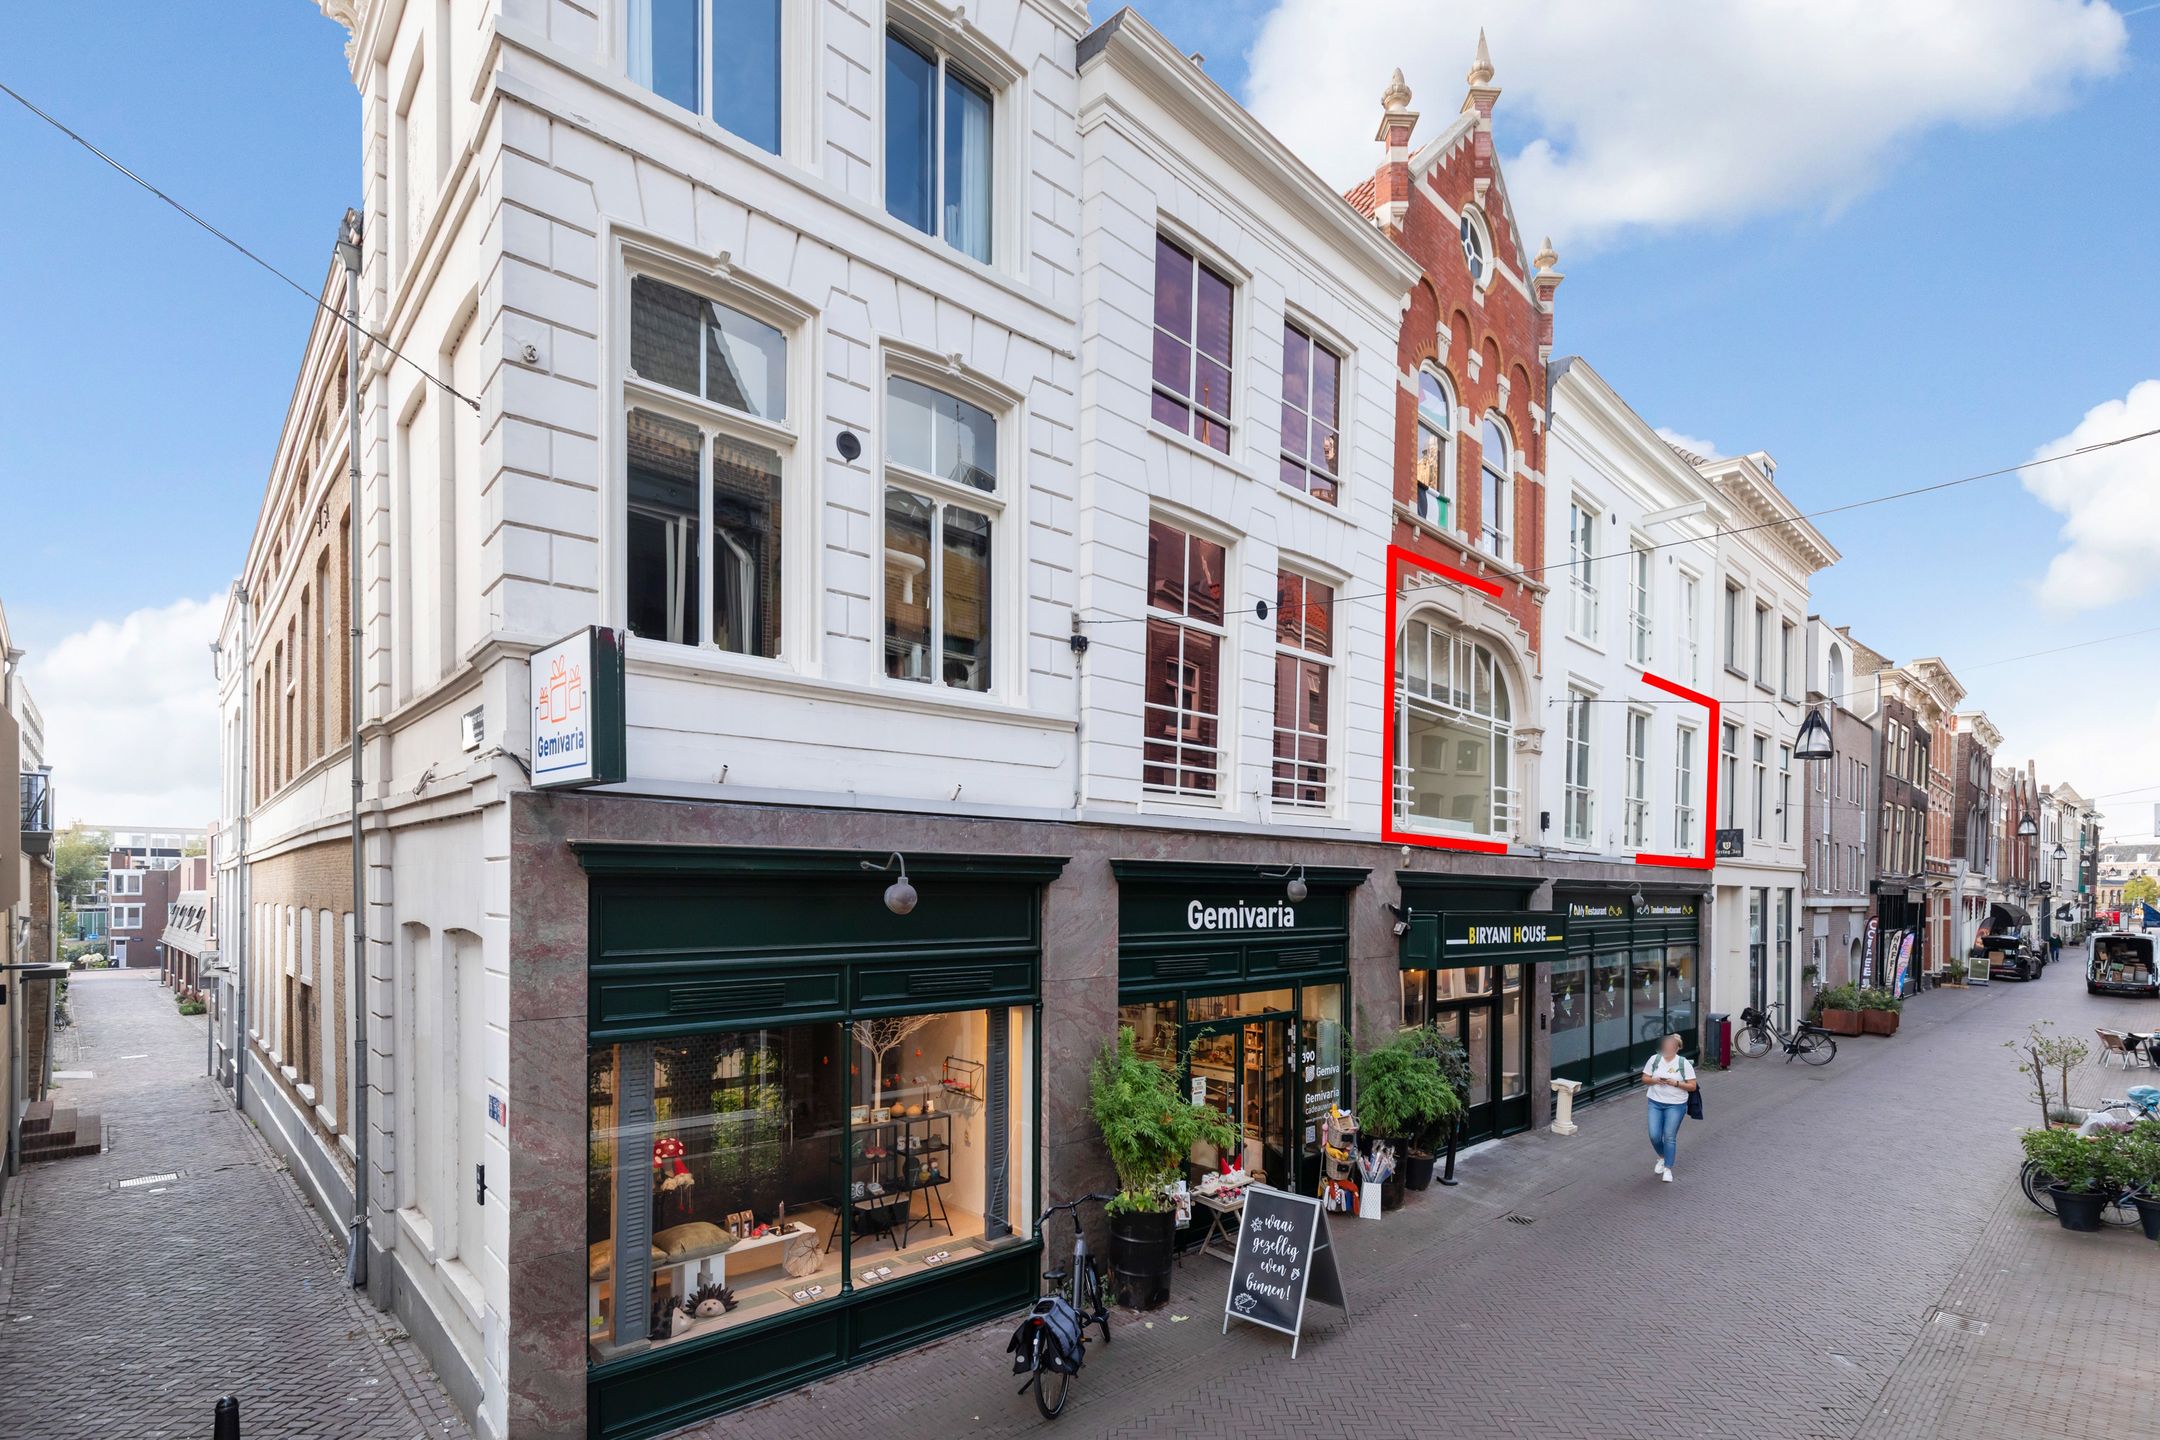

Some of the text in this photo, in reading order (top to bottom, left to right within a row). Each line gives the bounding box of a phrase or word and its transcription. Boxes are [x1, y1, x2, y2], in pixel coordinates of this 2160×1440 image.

[537, 727, 584, 758] Gemivaria
[1187, 899, 1295, 930] Gemivaria
[1468, 925, 1547, 944] BIRYANI HOUSE
[1316, 1064, 1340, 1077] Gemiva
[1305, 1087, 1340, 1104] Gemivaria
[1264, 1214, 1295, 1233] waai
[1252, 1235, 1300, 1263] gezellig
[1260, 1258, 1287, 1277] even
[1246, 1272, 1291, 1300] binnen!
